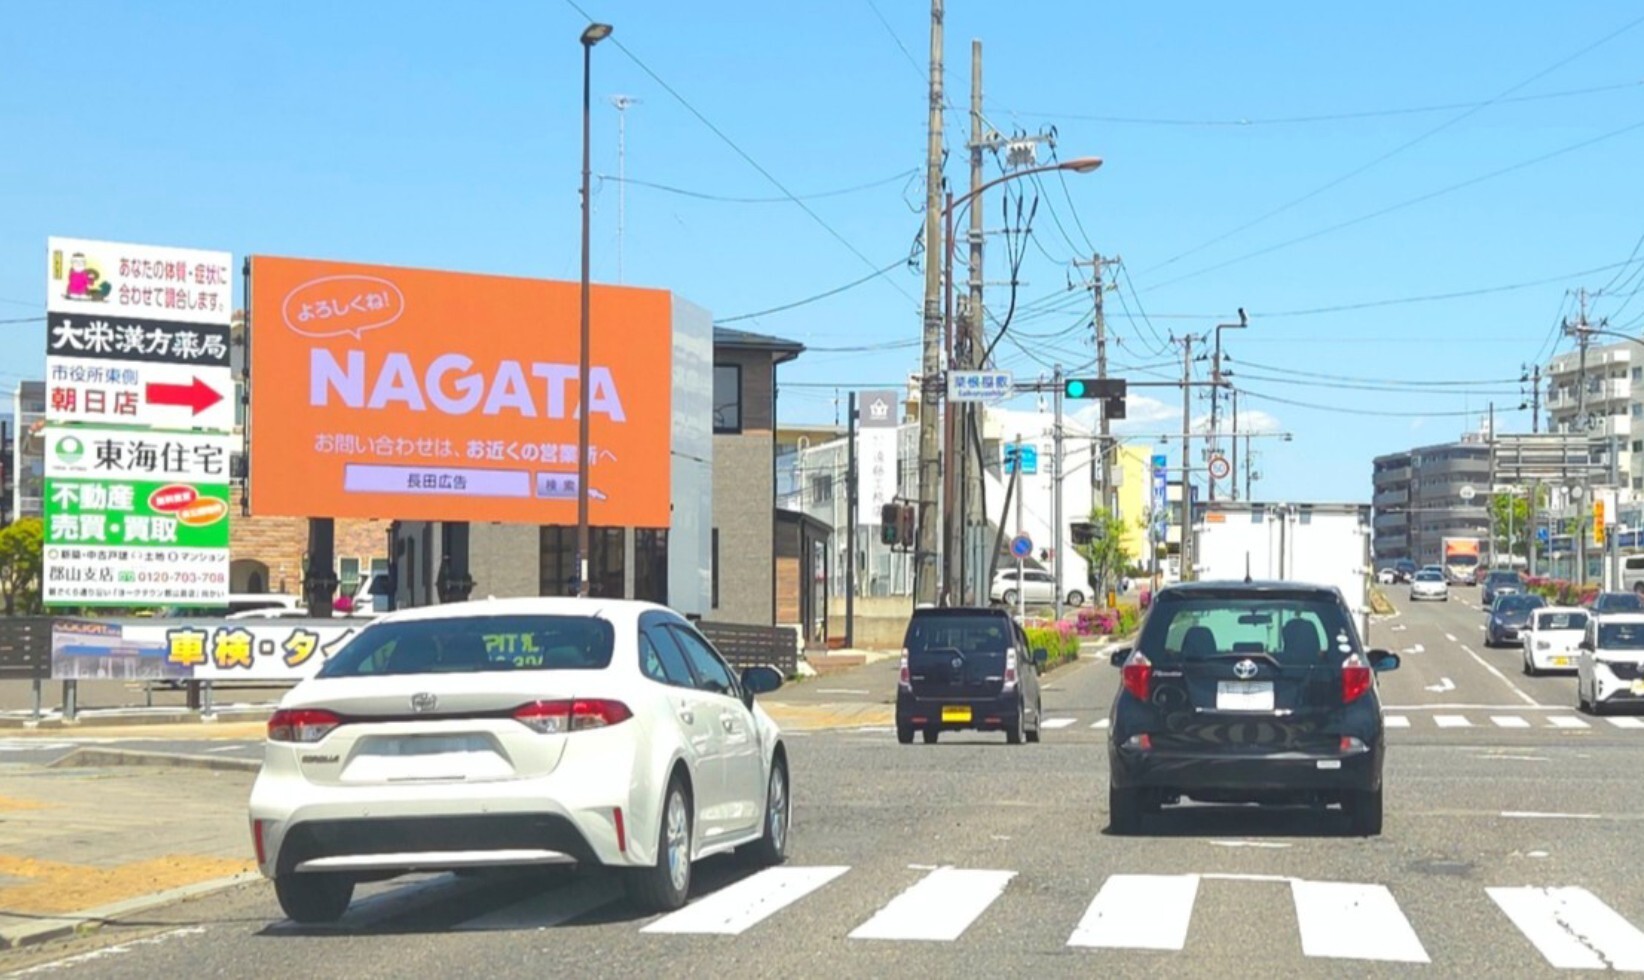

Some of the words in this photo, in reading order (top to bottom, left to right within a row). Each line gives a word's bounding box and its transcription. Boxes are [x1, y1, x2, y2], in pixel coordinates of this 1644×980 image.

[119, 256, 228, 286] あなたの体質・症状に
[119, 283, 224, 313] 合わせて調合します。
[51, 319, 228, 360] 大栄漢方薬局
[51, 364, 139, 385] 市役所東側
[309, 347, 627, 424] NAGATA
[51, 386, 140, 417] 朝日店
[93, 438, 224, 476] 東海住宅
[406, 472, 468, 491] 長田広告
[51, 482, 135, 512] 不動産
[51, 513, 179, 543] 売買・買取
[49, 564, 114, 583] 郡山支店
[138, 571, 225, 584] 0120-703-708
